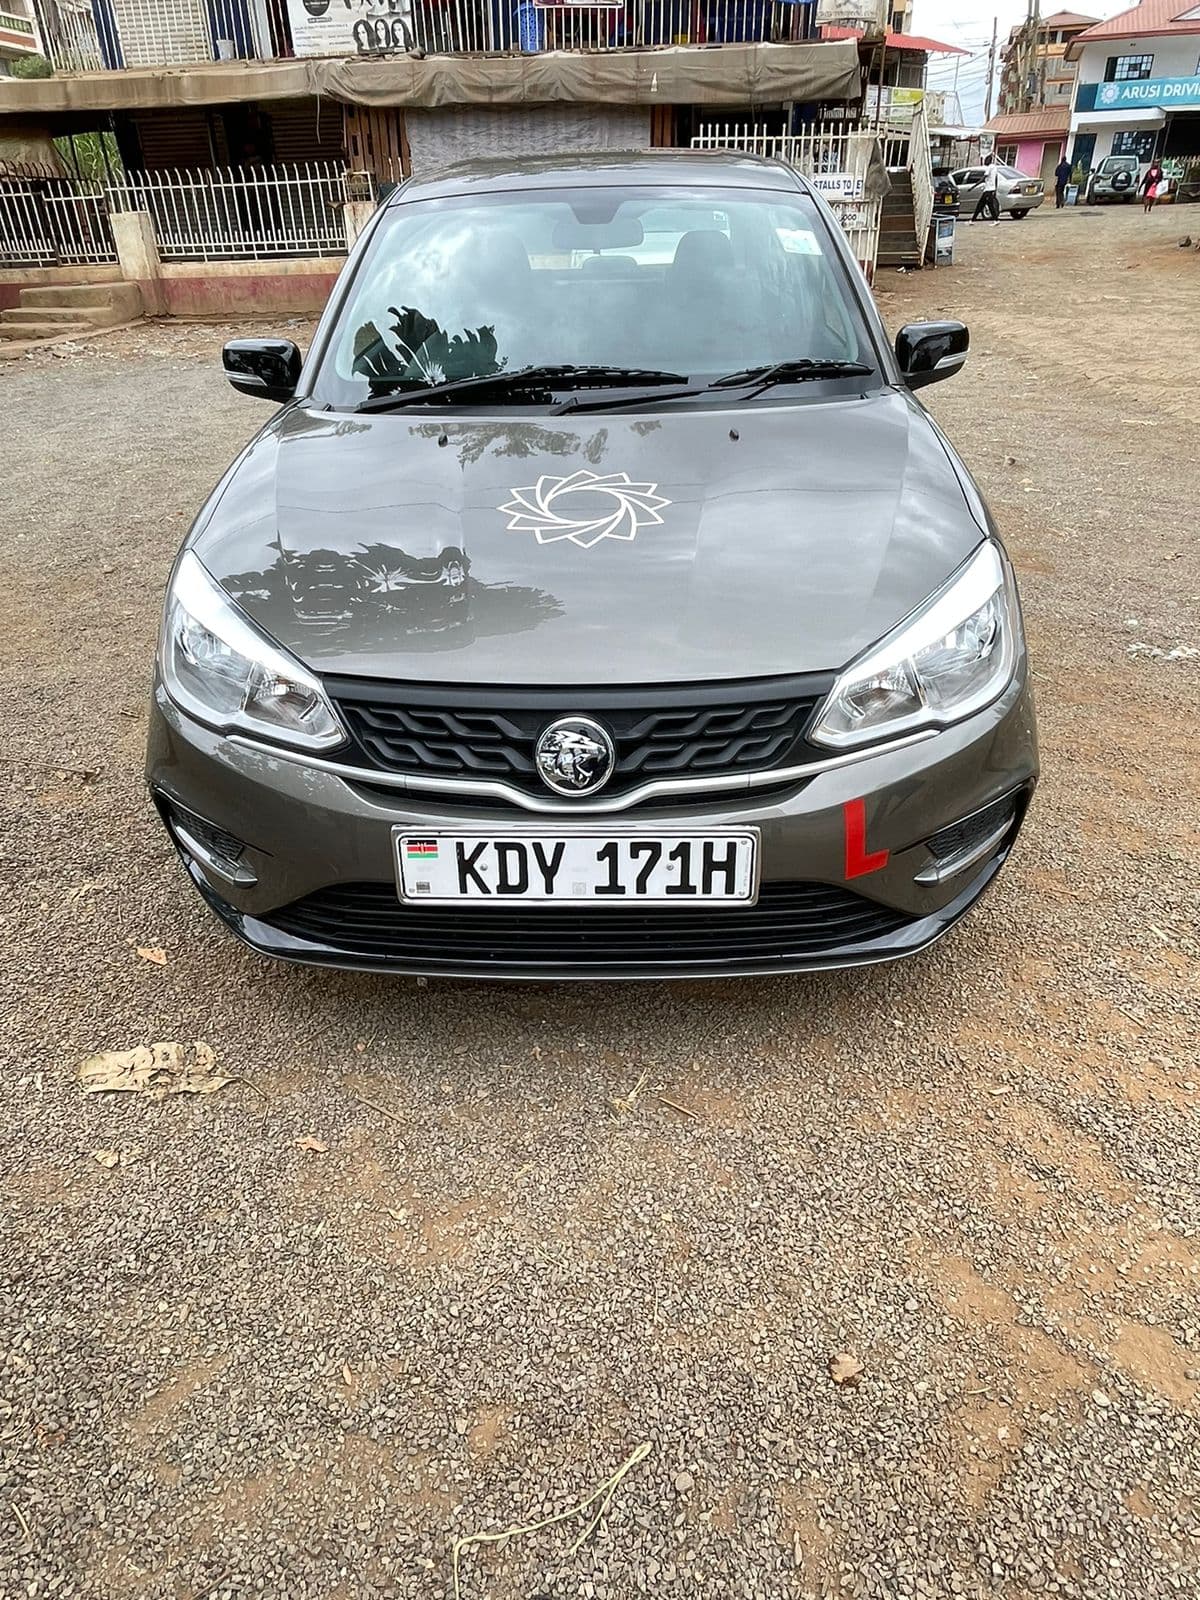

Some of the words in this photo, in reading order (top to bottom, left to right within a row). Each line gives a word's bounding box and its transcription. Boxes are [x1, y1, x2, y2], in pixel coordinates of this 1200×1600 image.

[1121, 85, 1161, 99] ARUSI
[1163, 82, 1200, 97] DRIVI
[813, 179, 841, 190] STALLS
[843, 180, 852, 190] TO
[844, 799, 891, 880] L
[455, 841, 566, 895] KDY
[594, 841, 738, 895] 171H
